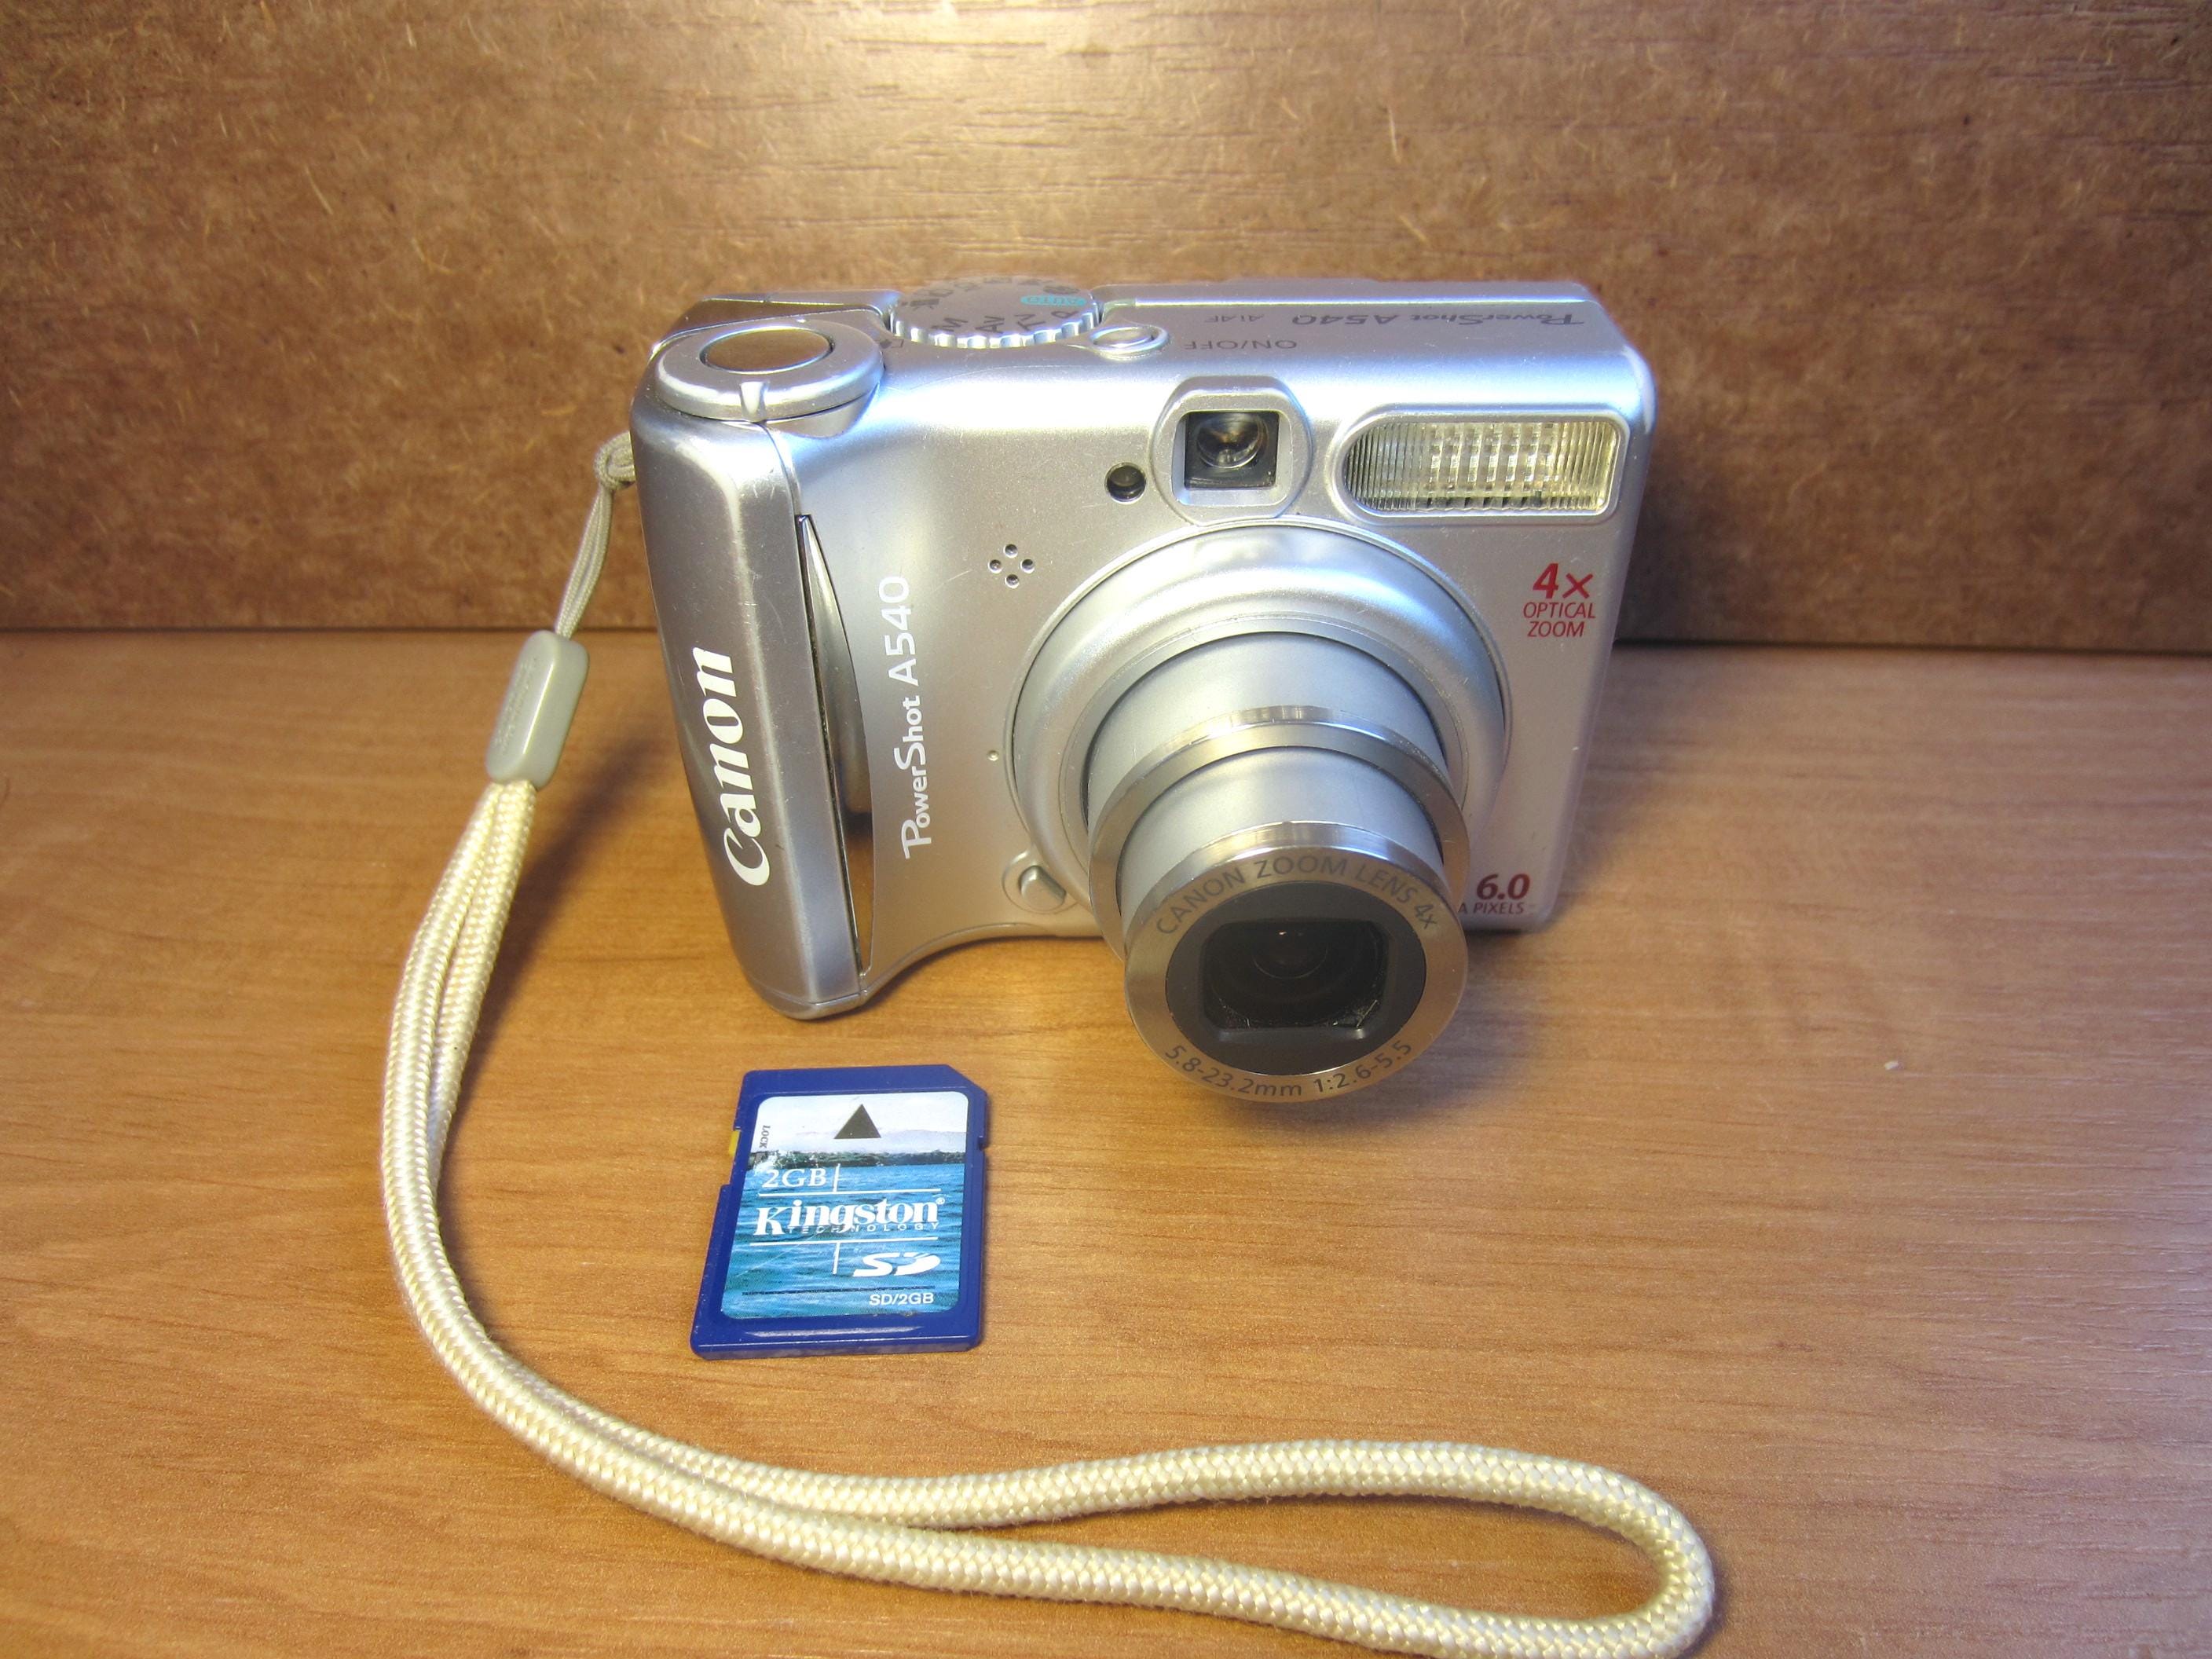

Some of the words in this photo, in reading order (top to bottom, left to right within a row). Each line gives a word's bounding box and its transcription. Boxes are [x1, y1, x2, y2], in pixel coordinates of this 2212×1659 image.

[931, 317, 969, 332] M
[1051, 310, 1079, 319] P
[1291, 314, 1400, 326] A540
[1411, 313, 1584, 326] PowerShot
[1183, 339, 1298, 350] ON/OFF
[1523, 602, 1596, 619] OPTICAL
[878, 576, 920, 687] A540
[1527, 621, 1585, 638] ZOOM
[692, 646, 771, 887] Canon
[893, 695, 932, 859] PowerShot
[1156, 869, 1245, 936] CANON
[1254, 855, 1347, 879] ZOOM
[1355, 866, 1422, 904] LENS
[1476, 873, 1531, 901] 6.0
[1474, 901, 1525, 915] PIXELS
[1164, 1045, 1303, 1097] 5.8-23.2mm
[1313, 1040, 1412, 1093] 1:2.6-5.5
[759, 1125, 771, 1148] LOCK
[762, 1168, 827, 1188] 2GB
[753, 1199, 939, 1236] Kingston
[853, 1252, 941, 1277] SD
[869, 1292, 935, 1306] SD/2GB
